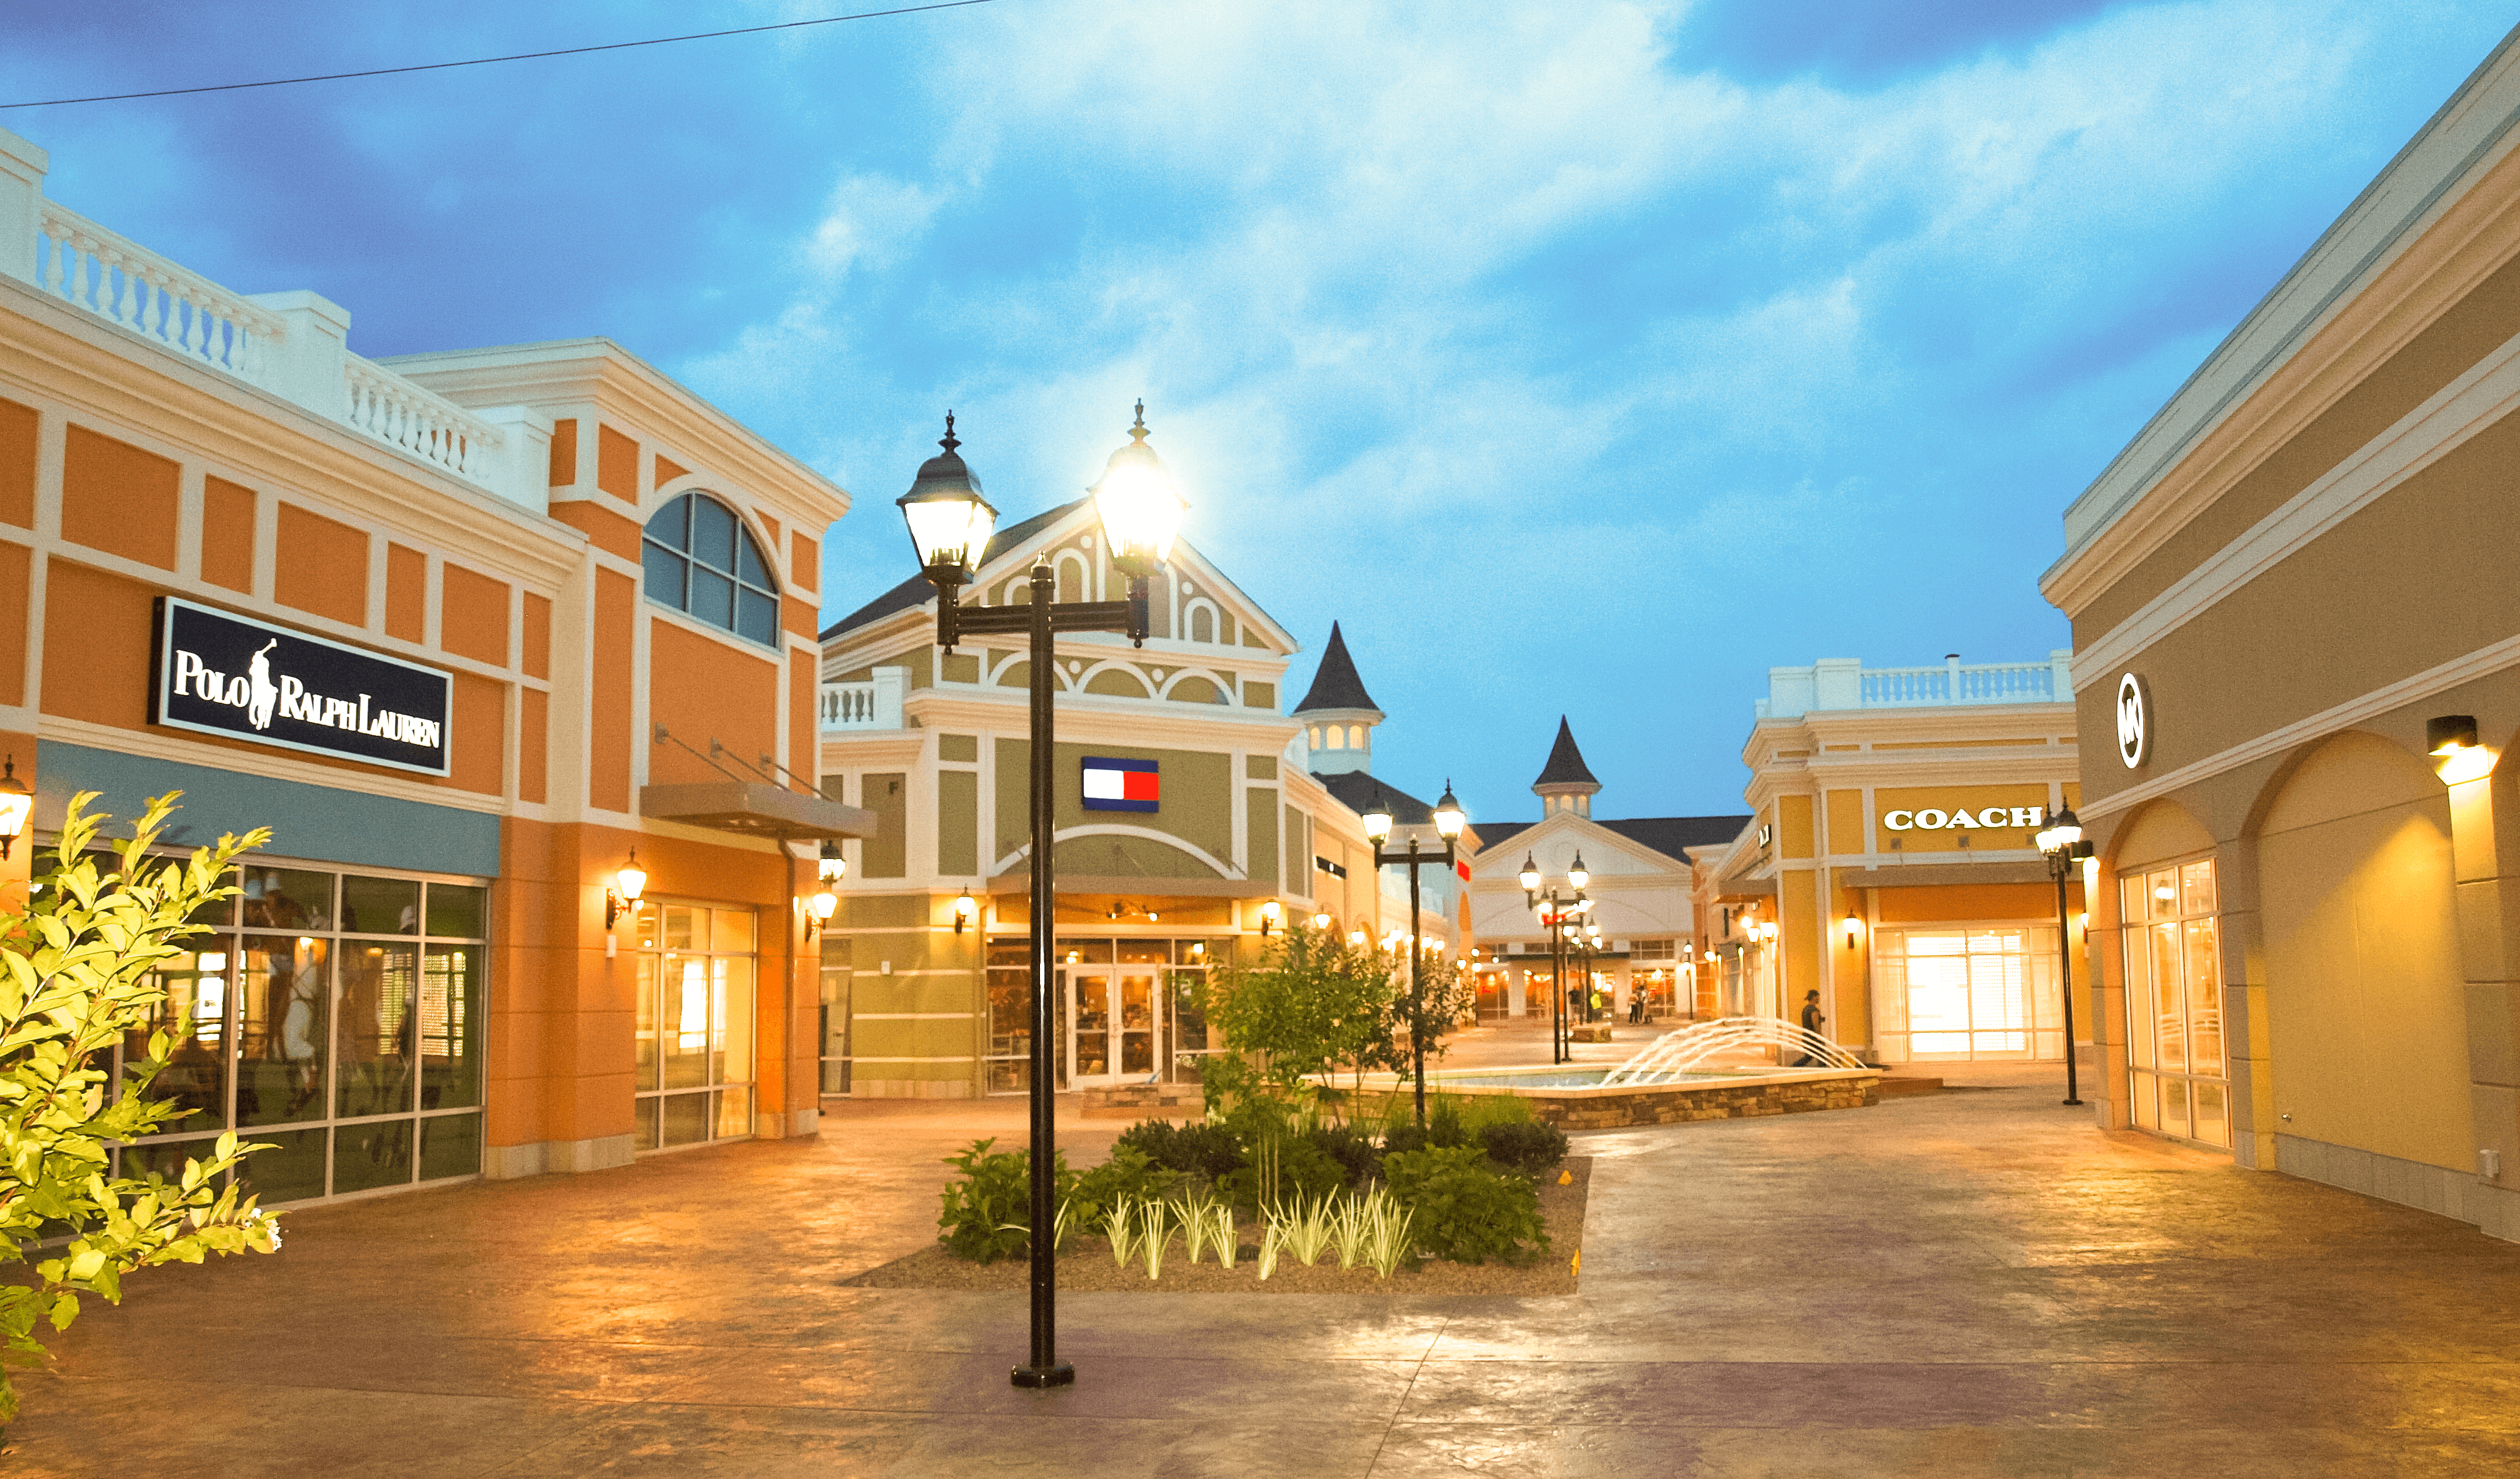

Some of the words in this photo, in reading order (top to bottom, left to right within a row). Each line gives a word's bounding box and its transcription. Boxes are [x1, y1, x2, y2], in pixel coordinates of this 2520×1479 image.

[174, 649, 251, 708] POLO
[279, 674, 358, 731] RALPH
[358, 693, 440, 748] LAUREN
[1884, 806, 2042, 830] COACH
